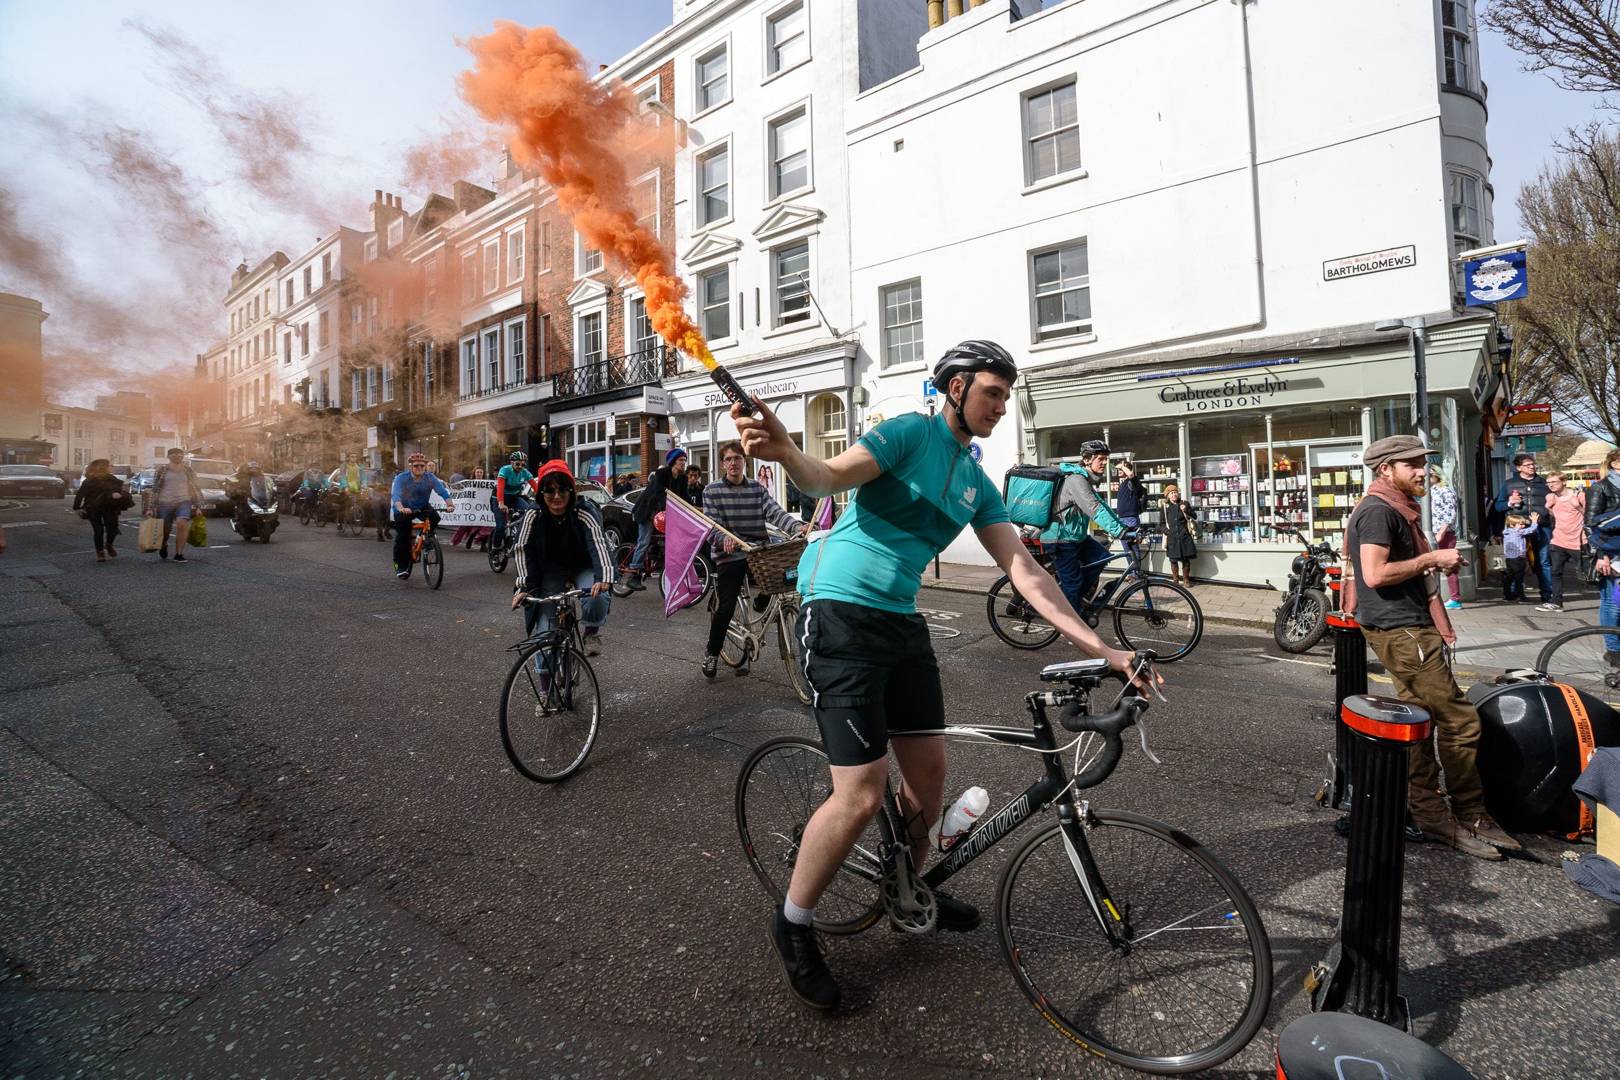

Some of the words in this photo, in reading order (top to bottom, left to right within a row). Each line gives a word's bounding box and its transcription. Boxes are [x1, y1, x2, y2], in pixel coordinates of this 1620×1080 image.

[1327, 255, 1411, 278] BARTHOLOMEWS
[1160, 386, 1221, 403] Crabtree
[1223, 381, 1235, 397] &
[1237, 377, 1288, 397] Evelyn
[704, 393, 732, 406] SPAC
[1187, 395, 1261, 411] LONDON
[475, 503, 490, 512] ON
[463, 513, 476, 522] TO
[480, 514, 496, 523] ALL
[943, 793, 1031, 872] SPECIALIZED
